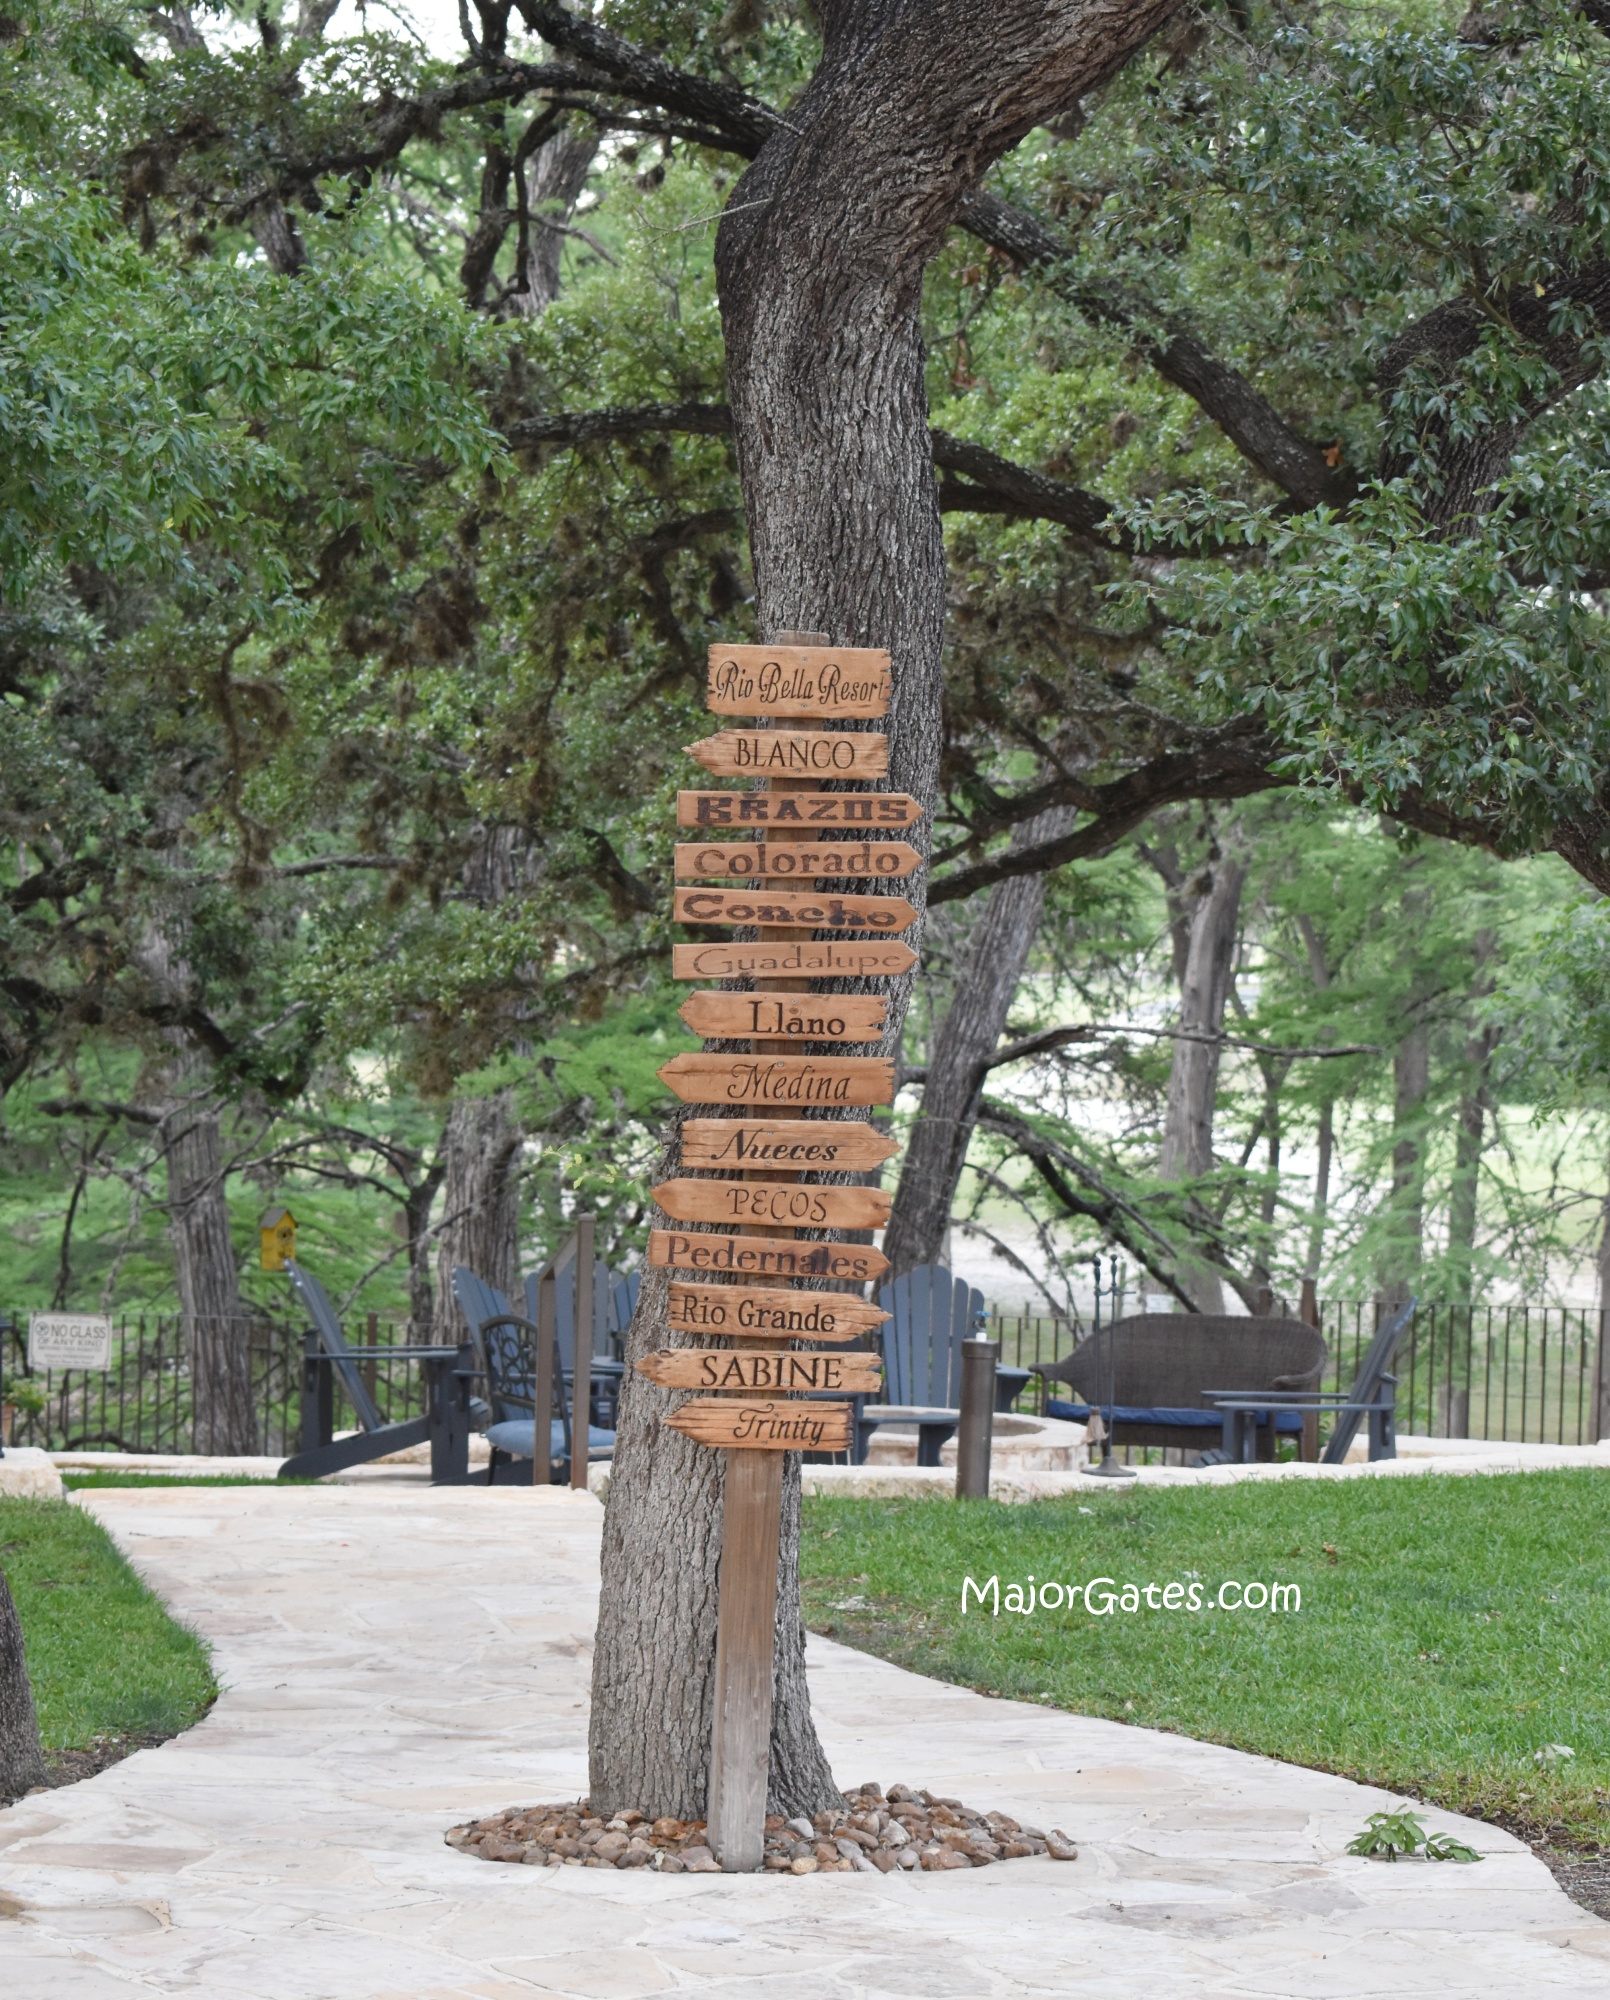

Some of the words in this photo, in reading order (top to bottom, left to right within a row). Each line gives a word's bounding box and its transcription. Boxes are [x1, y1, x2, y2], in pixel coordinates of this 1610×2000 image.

[716, 660, 753, 702] Rio
[758, 662, 814, 704] Bella
[818, 664, 889, 705] Resort
[733, 738, 856, 770] BLANCO
[695, 796, 908, 824] BRAZOS
[693, 843, 901, 875] Colorado
[682, 893, 897, 928] Concho
[693, 945, 902, 976] Guadalupe
[748, 1000, 846, 1036] Llano
[727, 1062, 851, 1101] Medina
[710, 1128, 839, 1162] Nueces
[726, 1188, 829, 1223] PECOS
[664, 1235, 869, 1279] Pedernales
[682, 1294, 726, 1325] Rio
[738, 1299, 836, 1332] Grande
[51, 1324, 67, 1337] NO
[70, 1325, 106, 1339] GLASS
[53, 1338, 75, 1346] ANY
[78, 1338, 103, 1347] KIND
[701, 1355, 843, 1389] SABINE
[733, 1402, 825, 1446] Trinity
